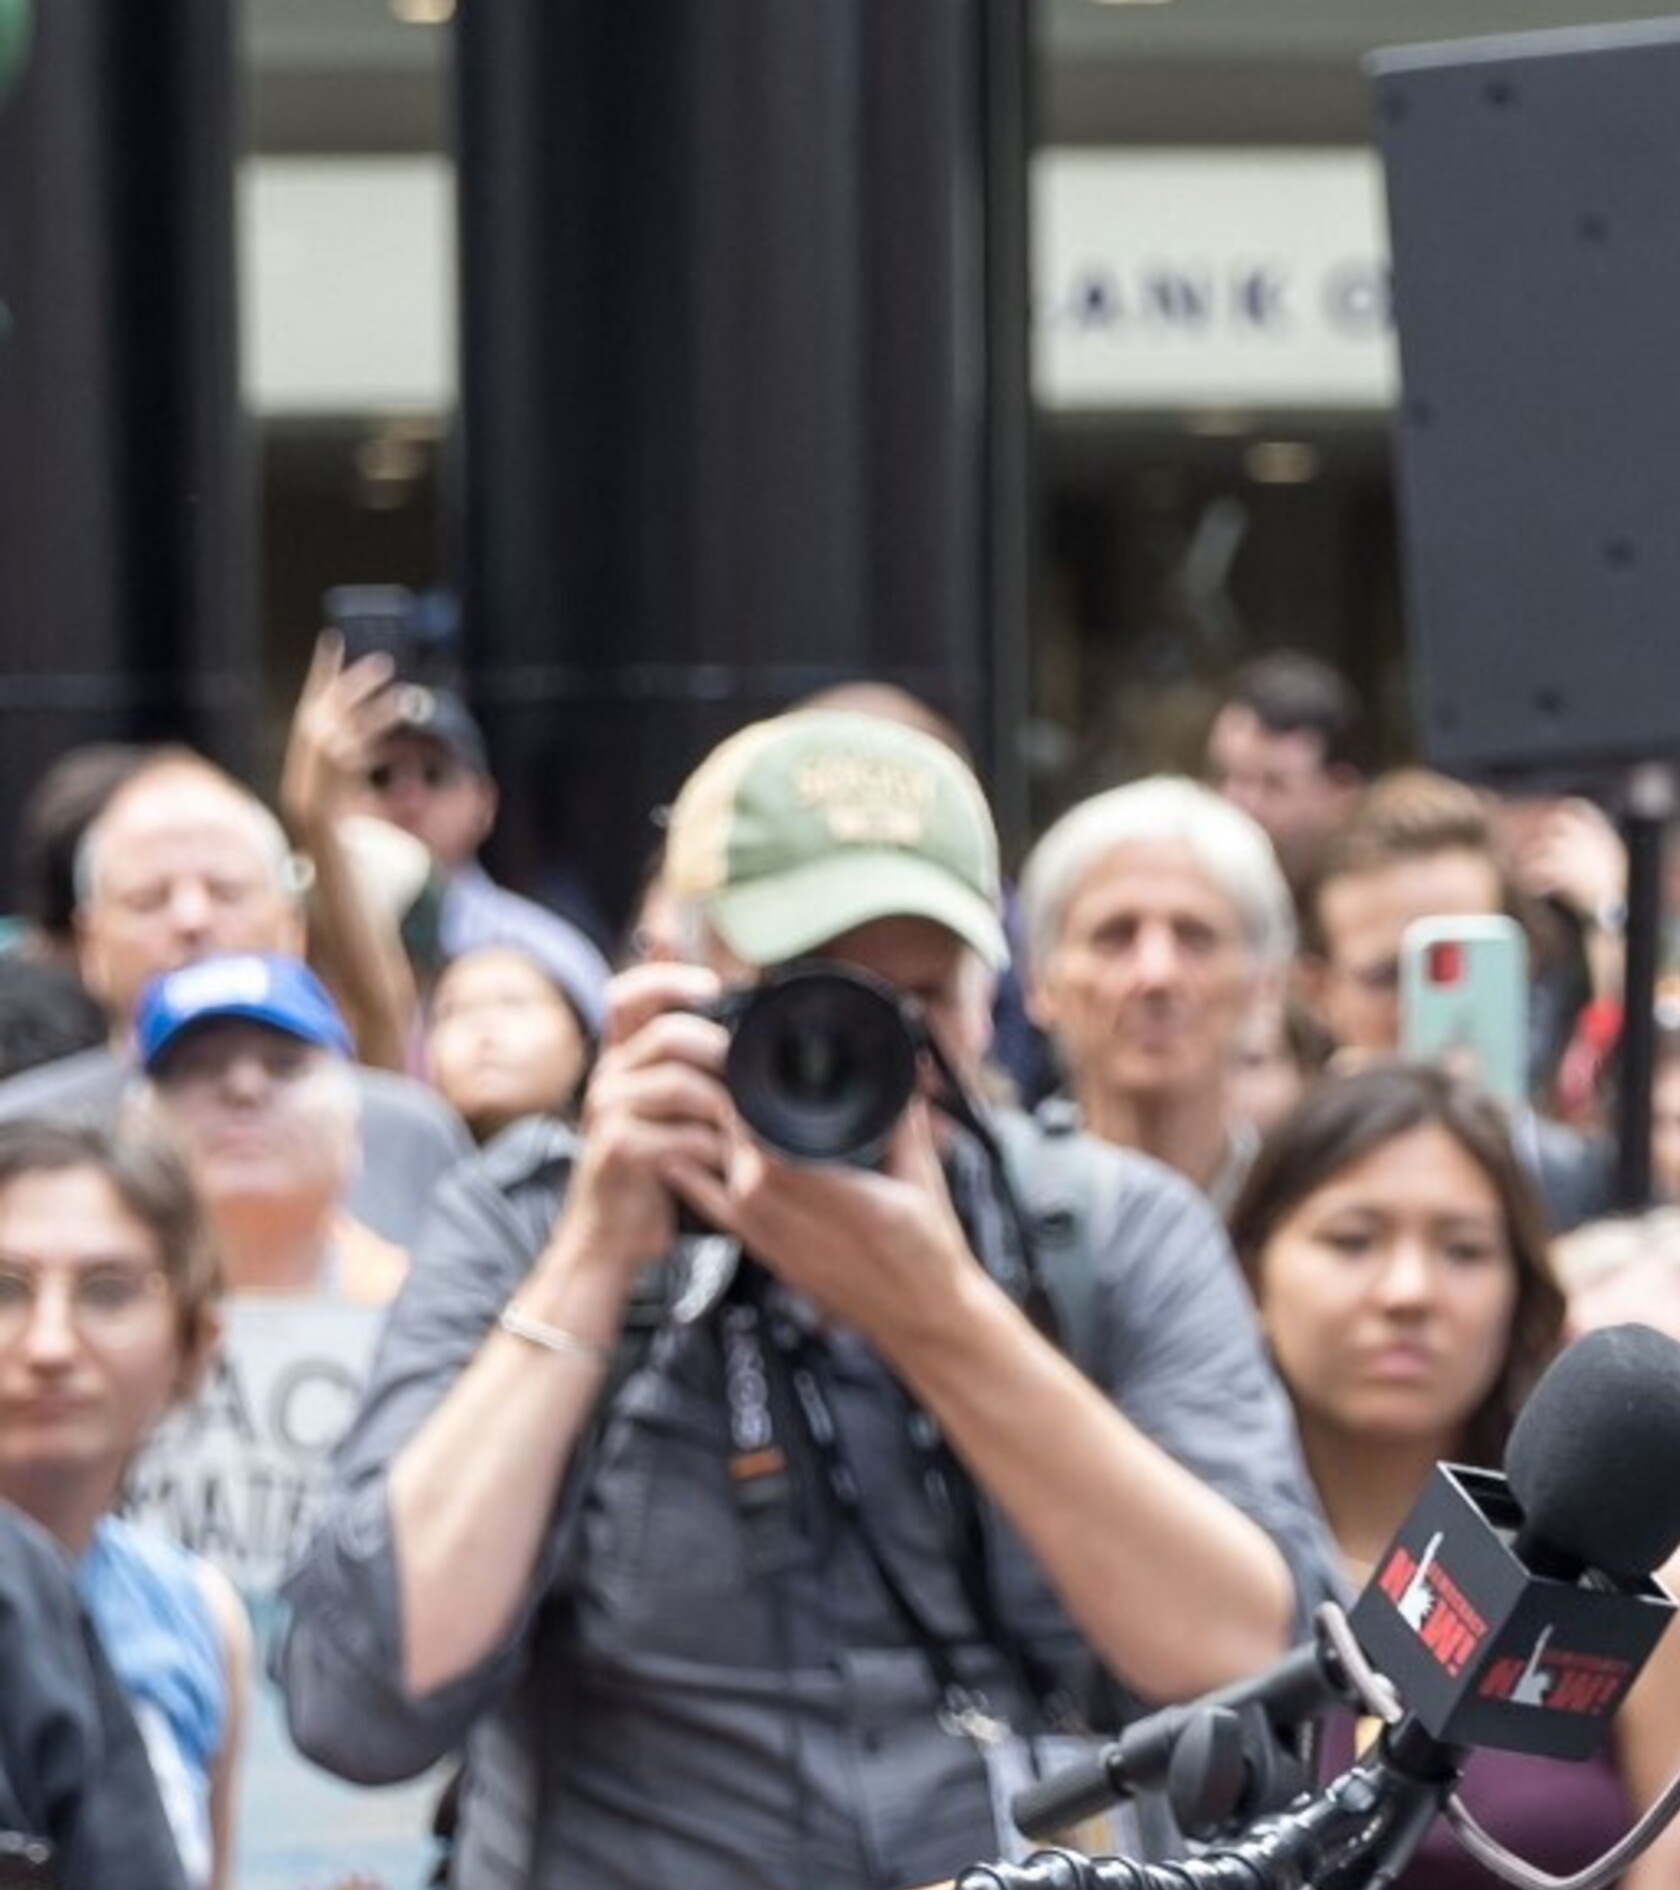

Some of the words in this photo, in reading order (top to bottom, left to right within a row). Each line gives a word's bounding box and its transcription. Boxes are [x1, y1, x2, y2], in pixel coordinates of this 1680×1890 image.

[1062, 258, 1292, 340] ANK
[1318, 260, 1394, 342] O
[182, 1352, 364, 1460] AC
